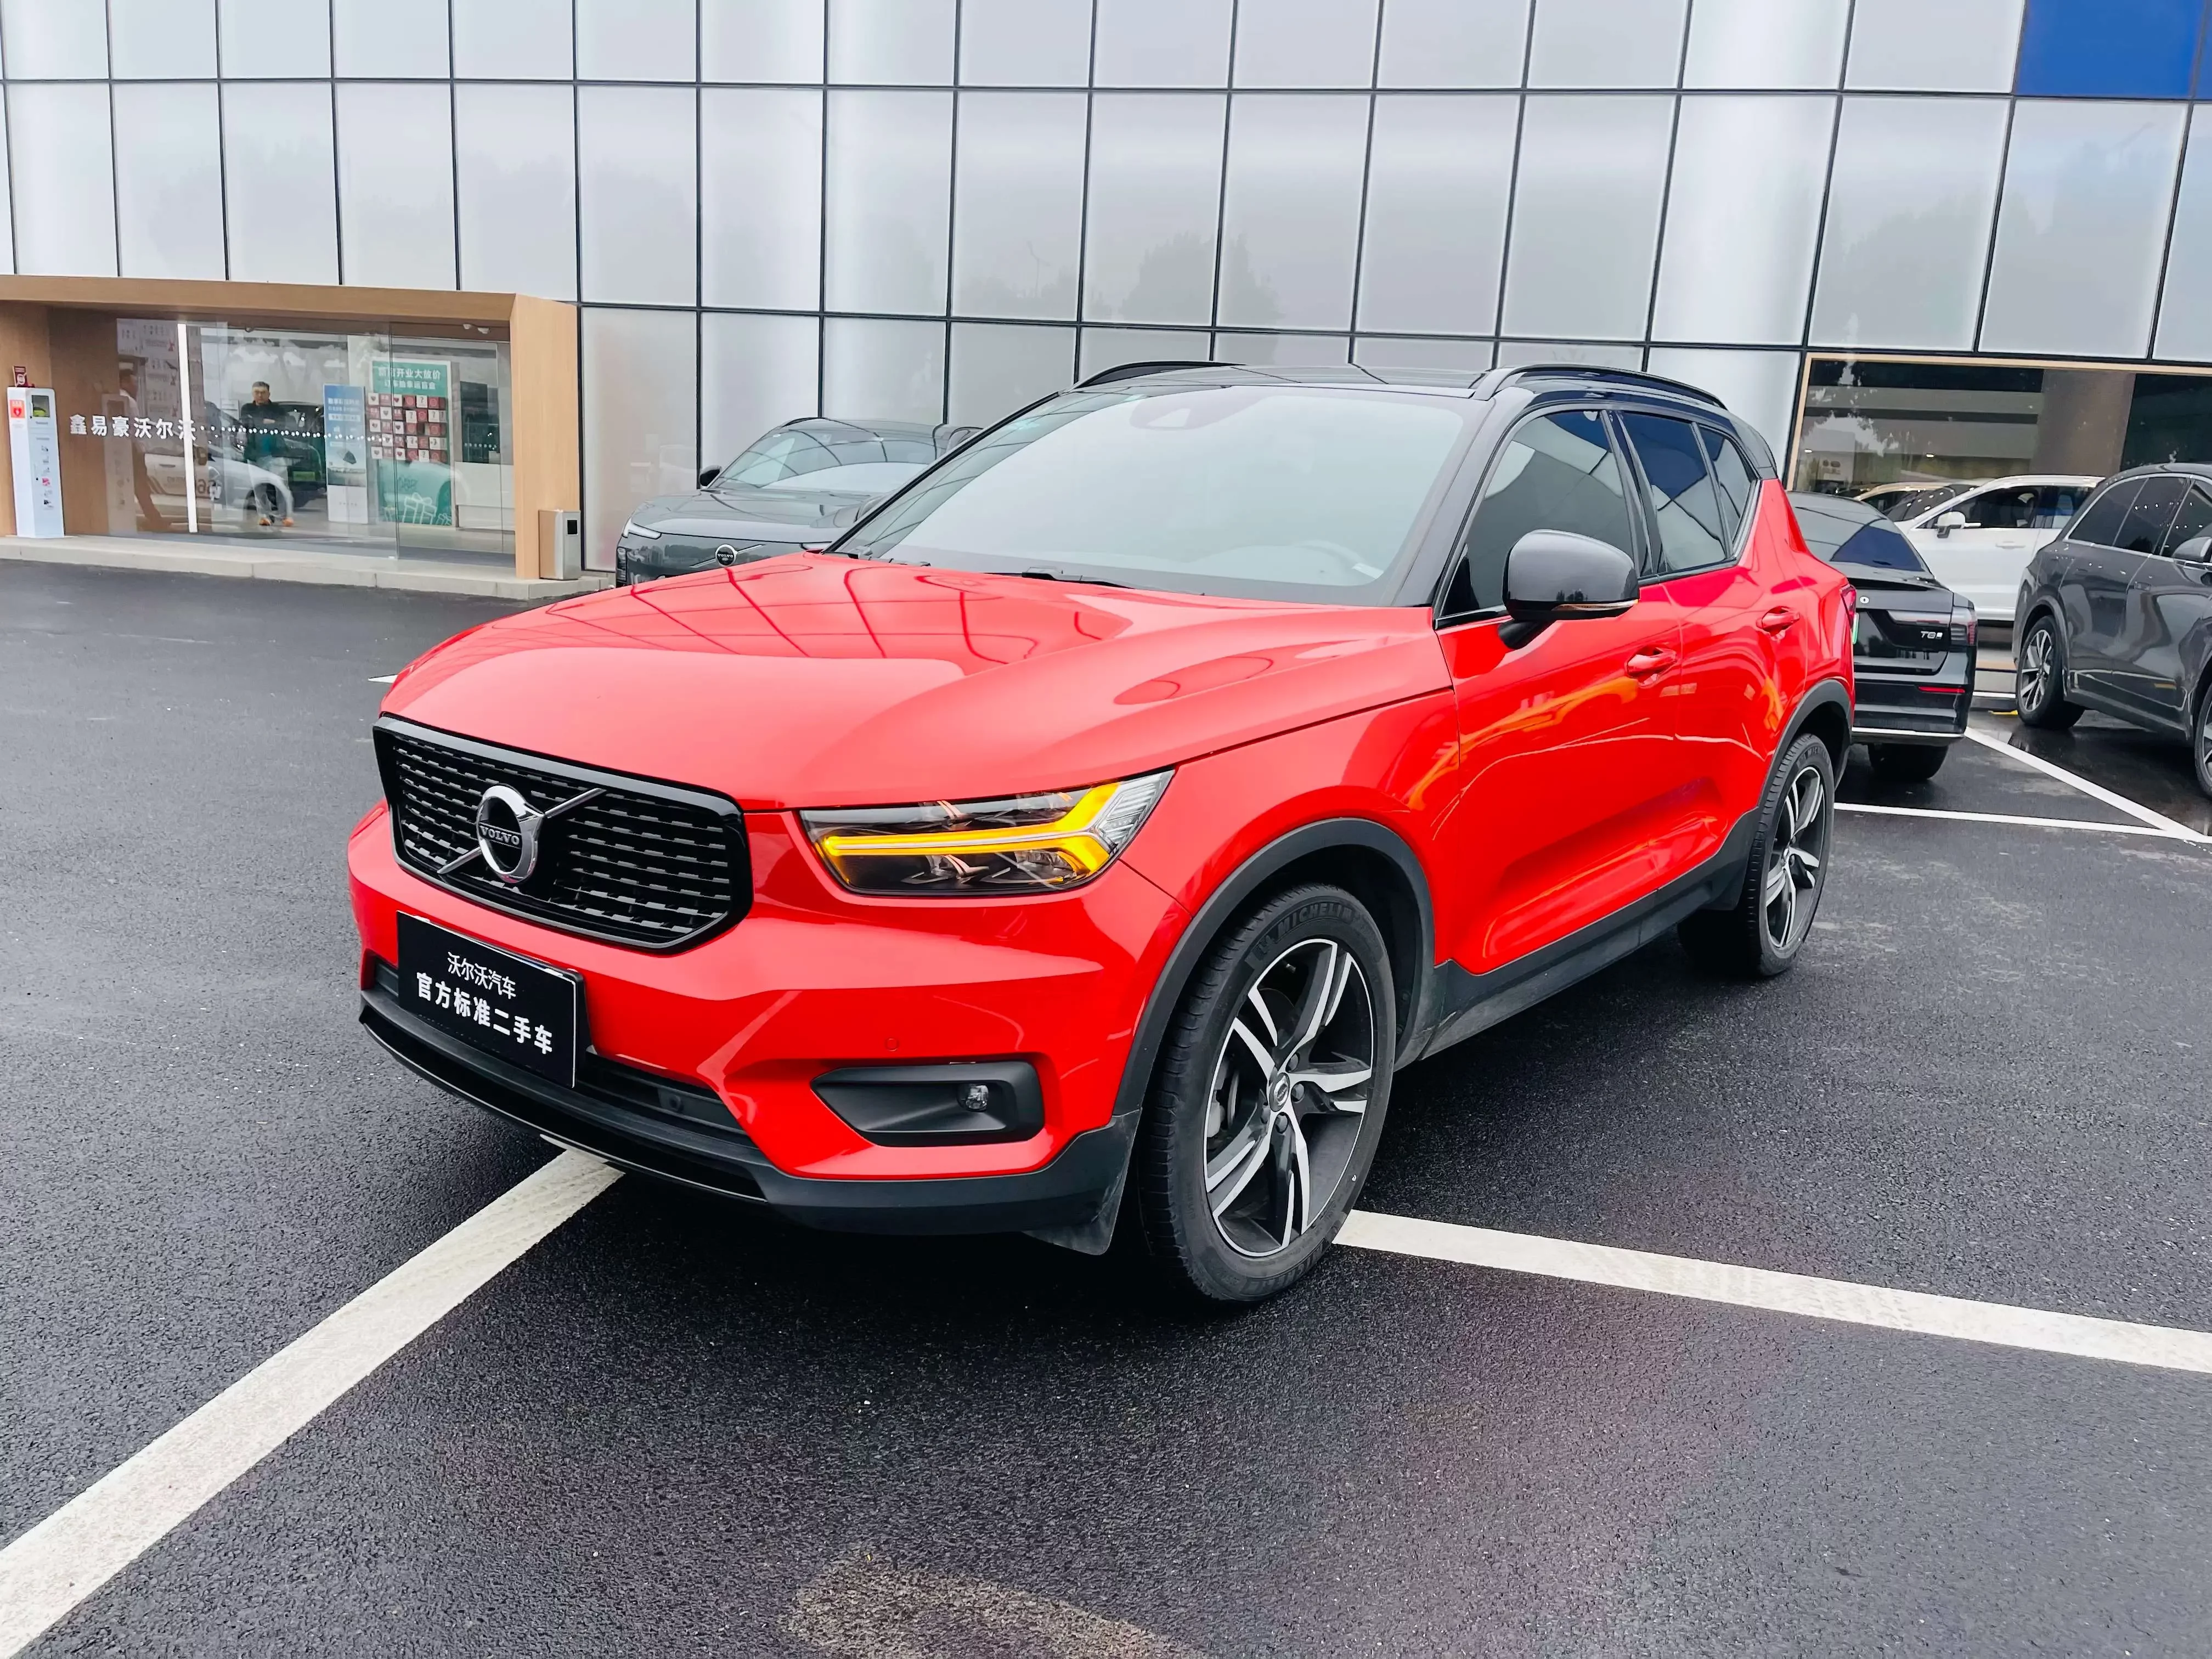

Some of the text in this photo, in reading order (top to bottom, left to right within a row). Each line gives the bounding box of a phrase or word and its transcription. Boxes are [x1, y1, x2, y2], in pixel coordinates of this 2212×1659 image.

[479, 825, 520, 845] VOLVO
[1277, 902, 1353, 938] MICHELIN
[447, 951, 516, 1000] 沃尔沃汽车
[416, 972, 553, 1054] 官方标准二手车
